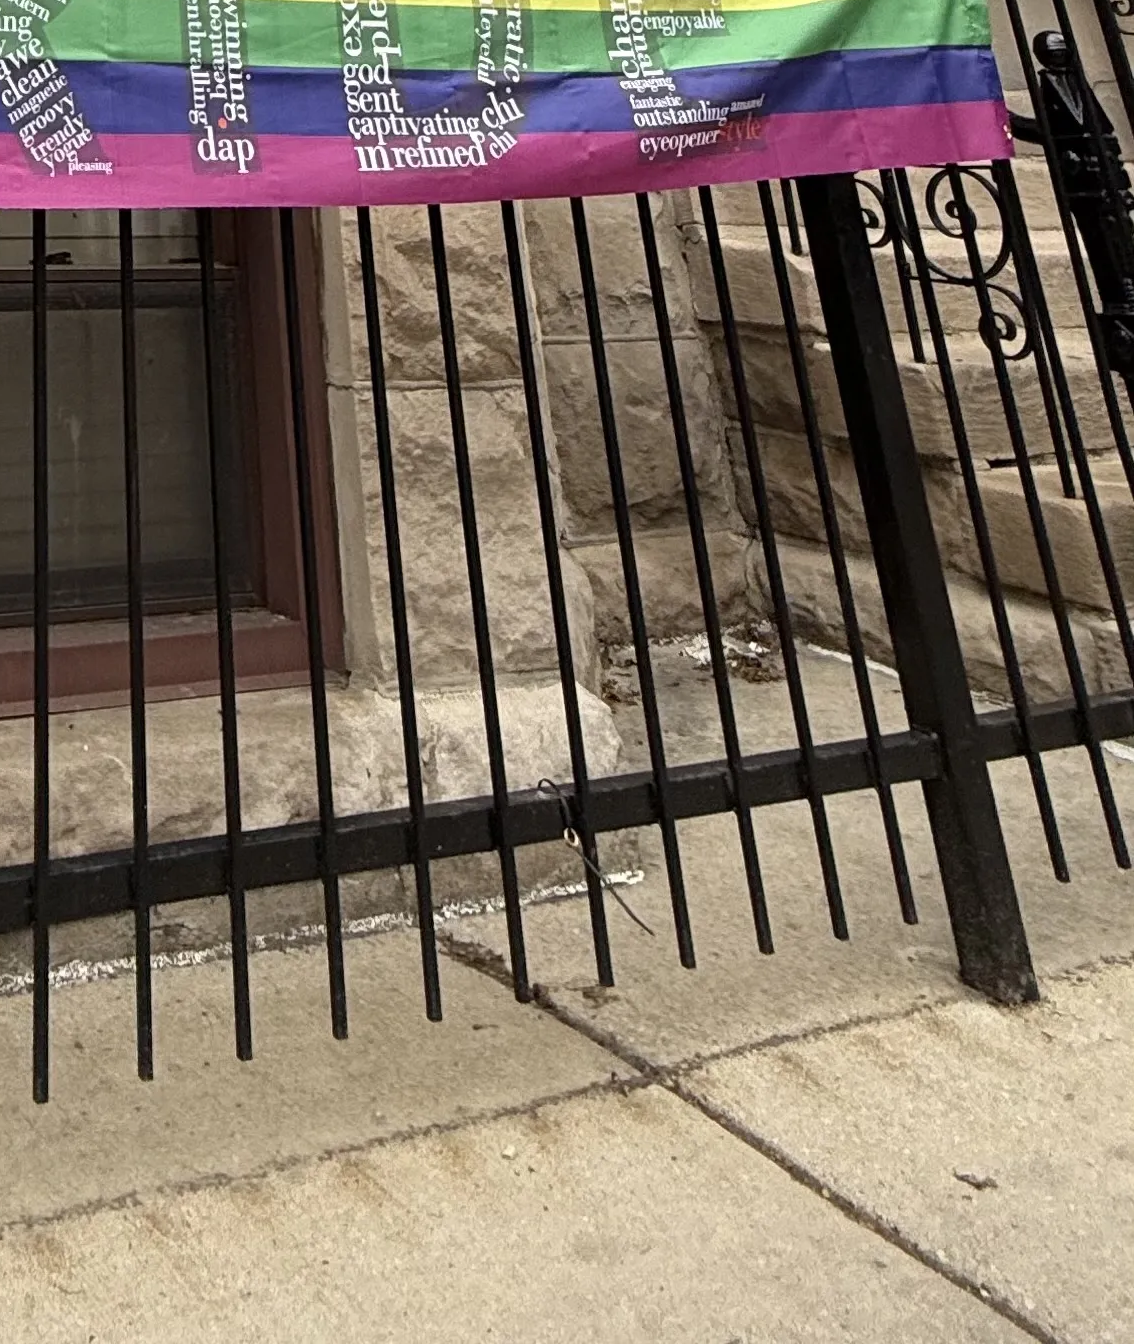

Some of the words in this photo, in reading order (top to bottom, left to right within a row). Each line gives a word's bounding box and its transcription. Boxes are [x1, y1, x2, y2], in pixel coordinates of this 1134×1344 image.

[1, 58, 59, 107] clean
[343, 53, 393, 96] god
[620, 76, 676, 93] engaging
[7, 75, 68, 125] magnetic
[346, 87, 404, 113] sent
[481, 86, 525, 129] chi
[629, 92, 683, 109] fantastic
[633, 100, 729, 126] outstanding
[18, 92, 74, 149] groovy
[30, 113, 84, 162] trendy
[348, 107, 479, 146] captivating
[197, 125, 255, 174] dap
[391, 131, 488, 168] refined
[488, 125, 518, 159] chi
[640, 129, 721, 160] eyeopener
[68, 157, 113, 176] pleasing
